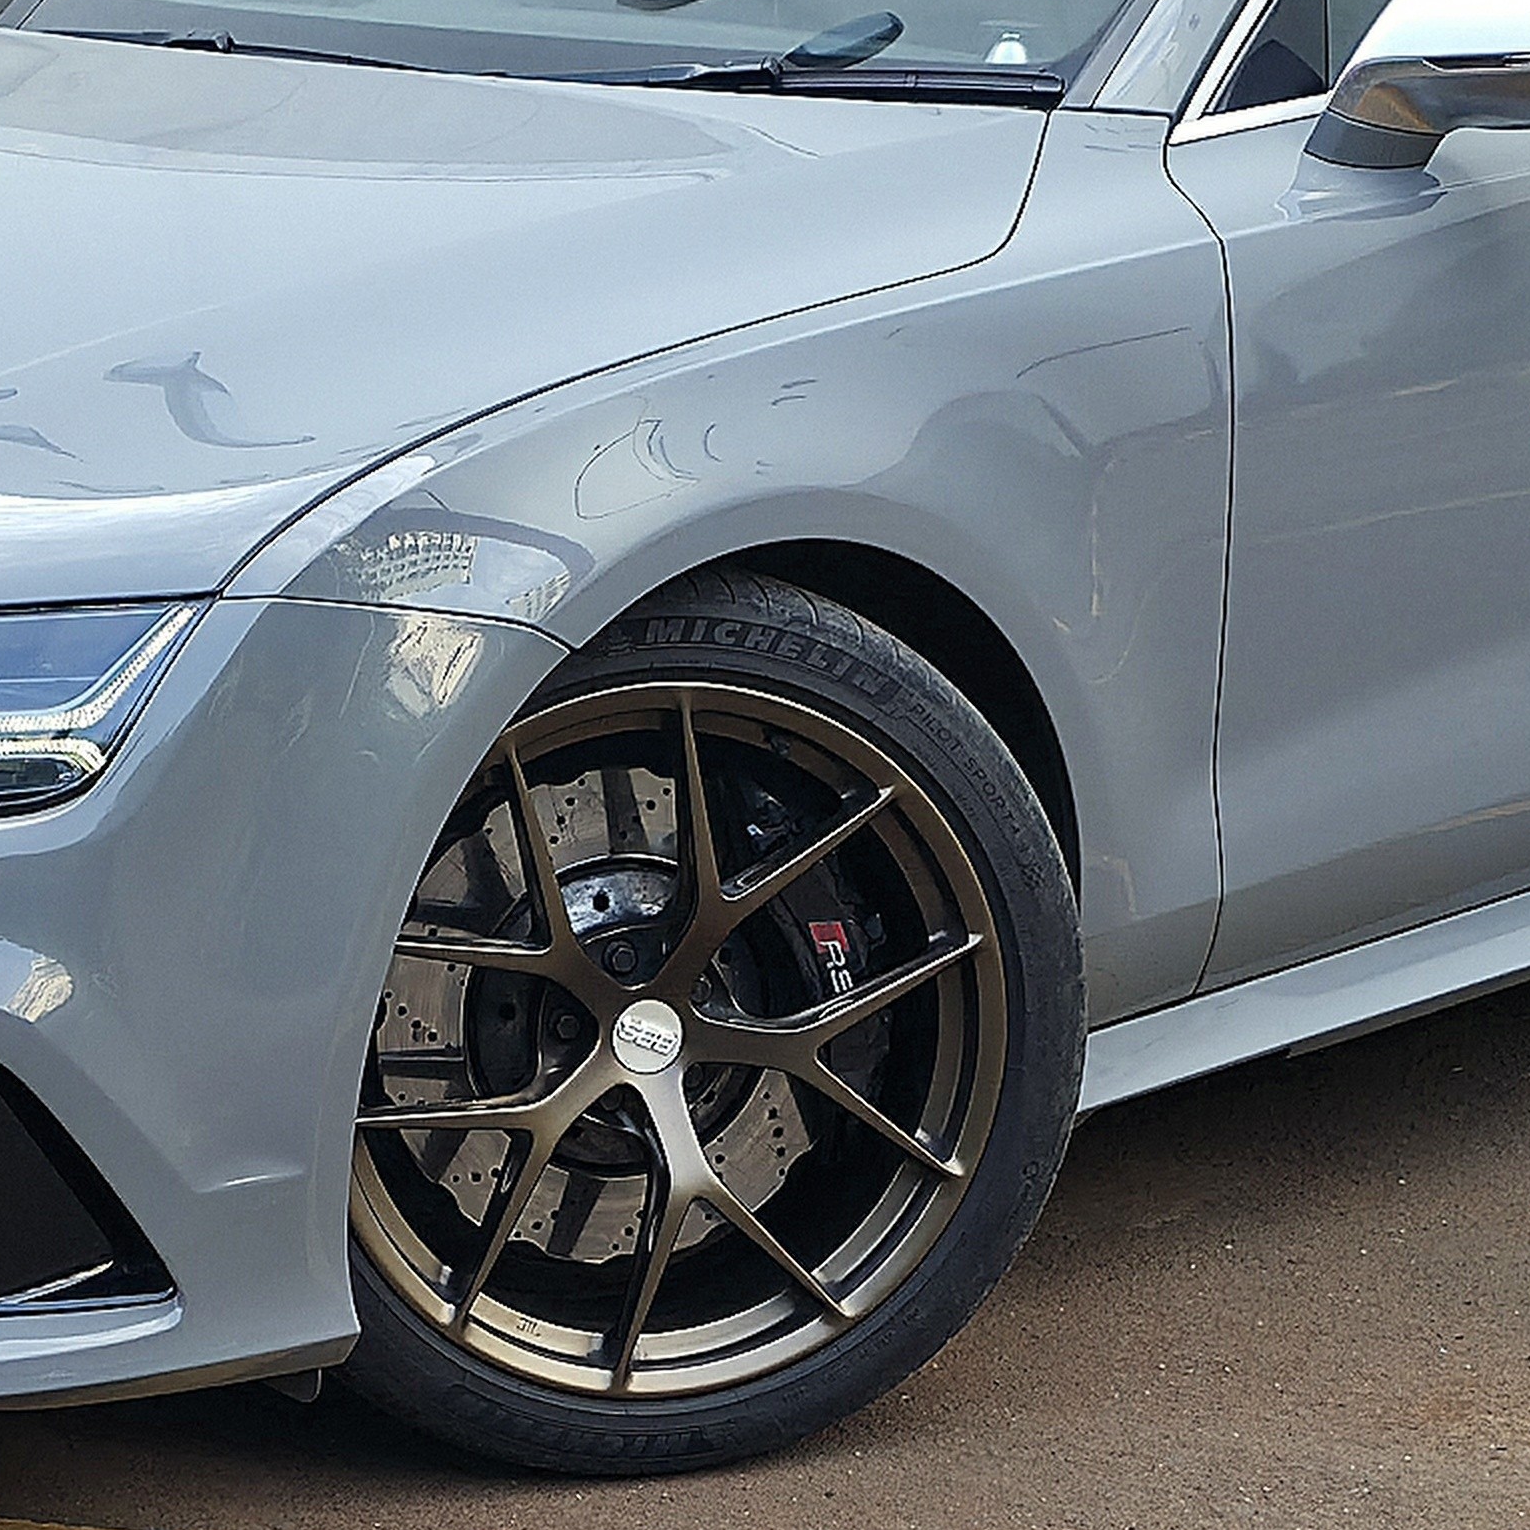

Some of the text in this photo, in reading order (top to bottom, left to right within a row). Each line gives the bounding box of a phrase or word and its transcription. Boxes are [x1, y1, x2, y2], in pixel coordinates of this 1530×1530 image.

[646, 618, 888, 697] MICHELIN
[908, 702, 964, 754] PILOT
[963, 757, 1017, 822] SPORT
